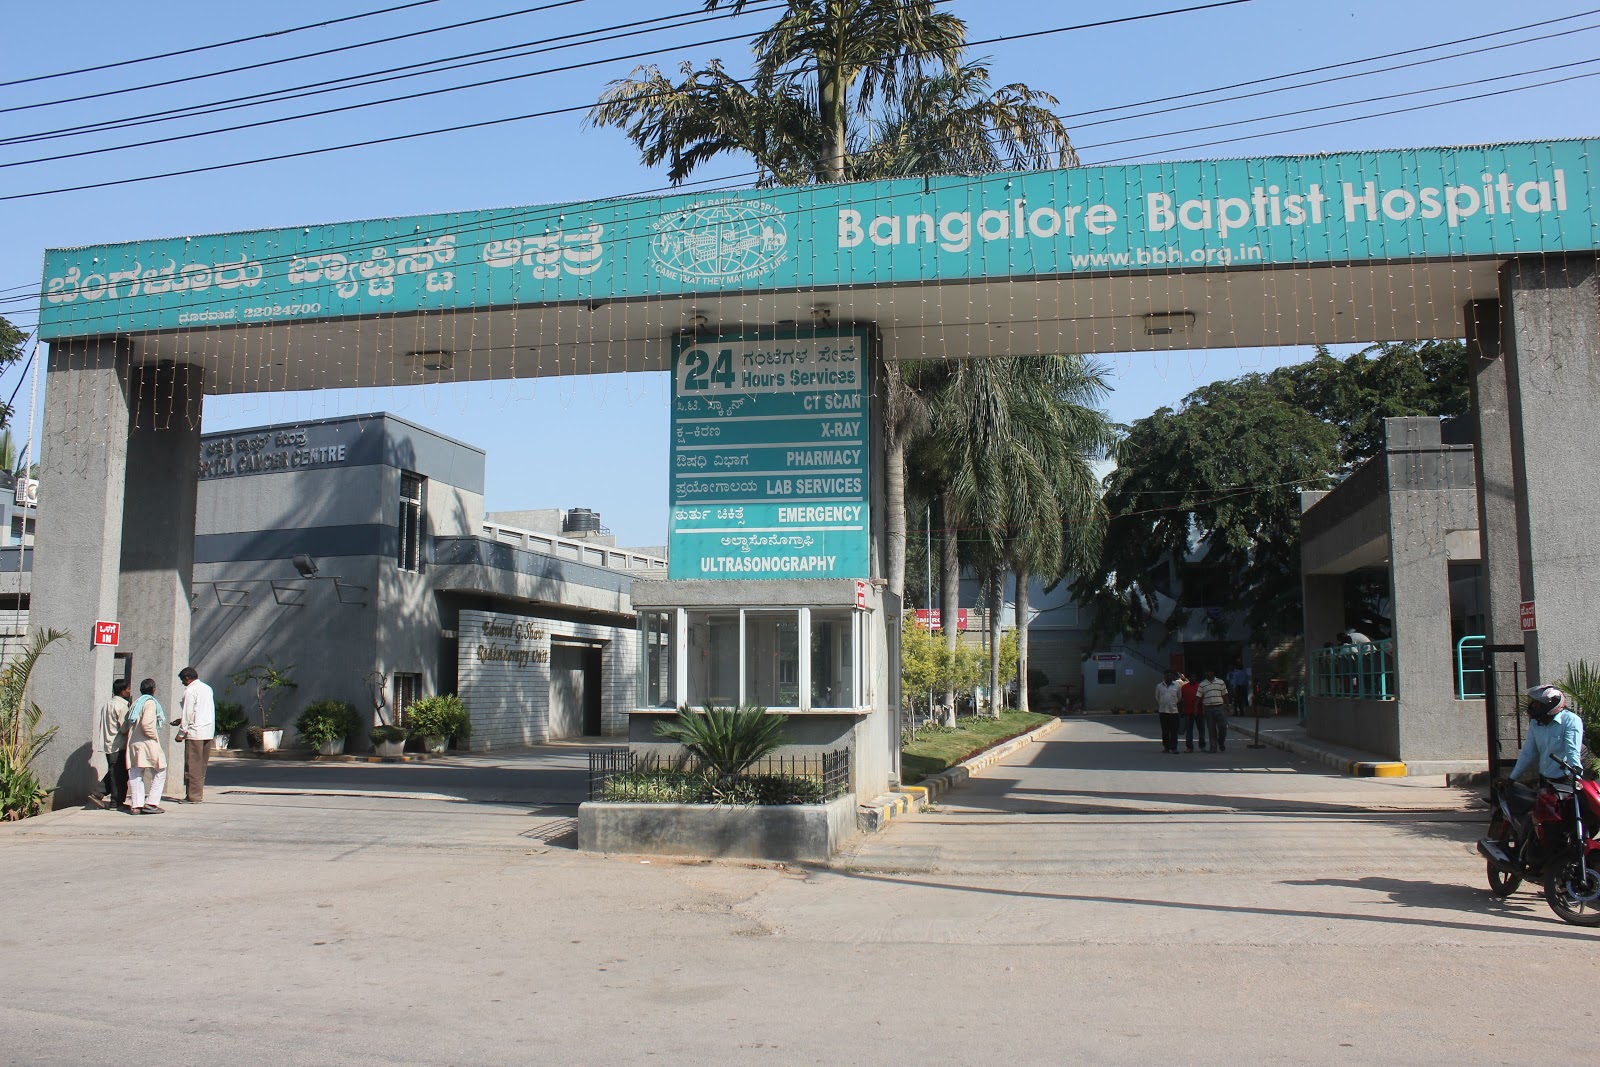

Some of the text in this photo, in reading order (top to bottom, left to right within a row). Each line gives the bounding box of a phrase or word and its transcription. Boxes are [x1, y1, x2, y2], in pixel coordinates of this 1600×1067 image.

[652, 198, 787, 231] BANGALORE BAPTIST HOSPITAL
[838, 169, 1567, 252] Bangalore Baptist Hospital
[47, 253, 262, 303] ಬೆಂಗಳೂರು
[482, 222, 603, 279] ಆಸ್ಪತ್ರೆ
[1071, 243, 1263, 268] www.bbh.org.in
[655, 265, 678, 280] CAME
[680, 273, 701, 285] THAT
[702, 276, 726, 285] THEY
[727, 273, 745, 283] MAY
[747, 267, 769, 280] HAVE
[243, 303, 321, 318] 22024700
[818, 345, 856, 363] ಸೇವೆ
[684, 349, 736, 390] 24
[742, 368, 856, 387] Hours Services
[804, 394, 861, 410] CT SCAN
[821, 422, 861, 437] X-RAY
[199, 445, 346, 477] PITAL CANCER CENTRE
[713, 453, 749, 467] ವಿಭಾಗ
[786, 450, 861, 466] PHARMACY
[675, 480, 758, 497] ಪ್ರಯೋಗಾಲಯ
[766, 477, 861, 495] LAB SERVICES
[778, 506, 861, 522] EMERGENCY
[701, 556, 836, 572] ULTRASONOGRAPHY
[1522, 617, 1534, 628] OUT
[102, 634, 112, 643] IN
